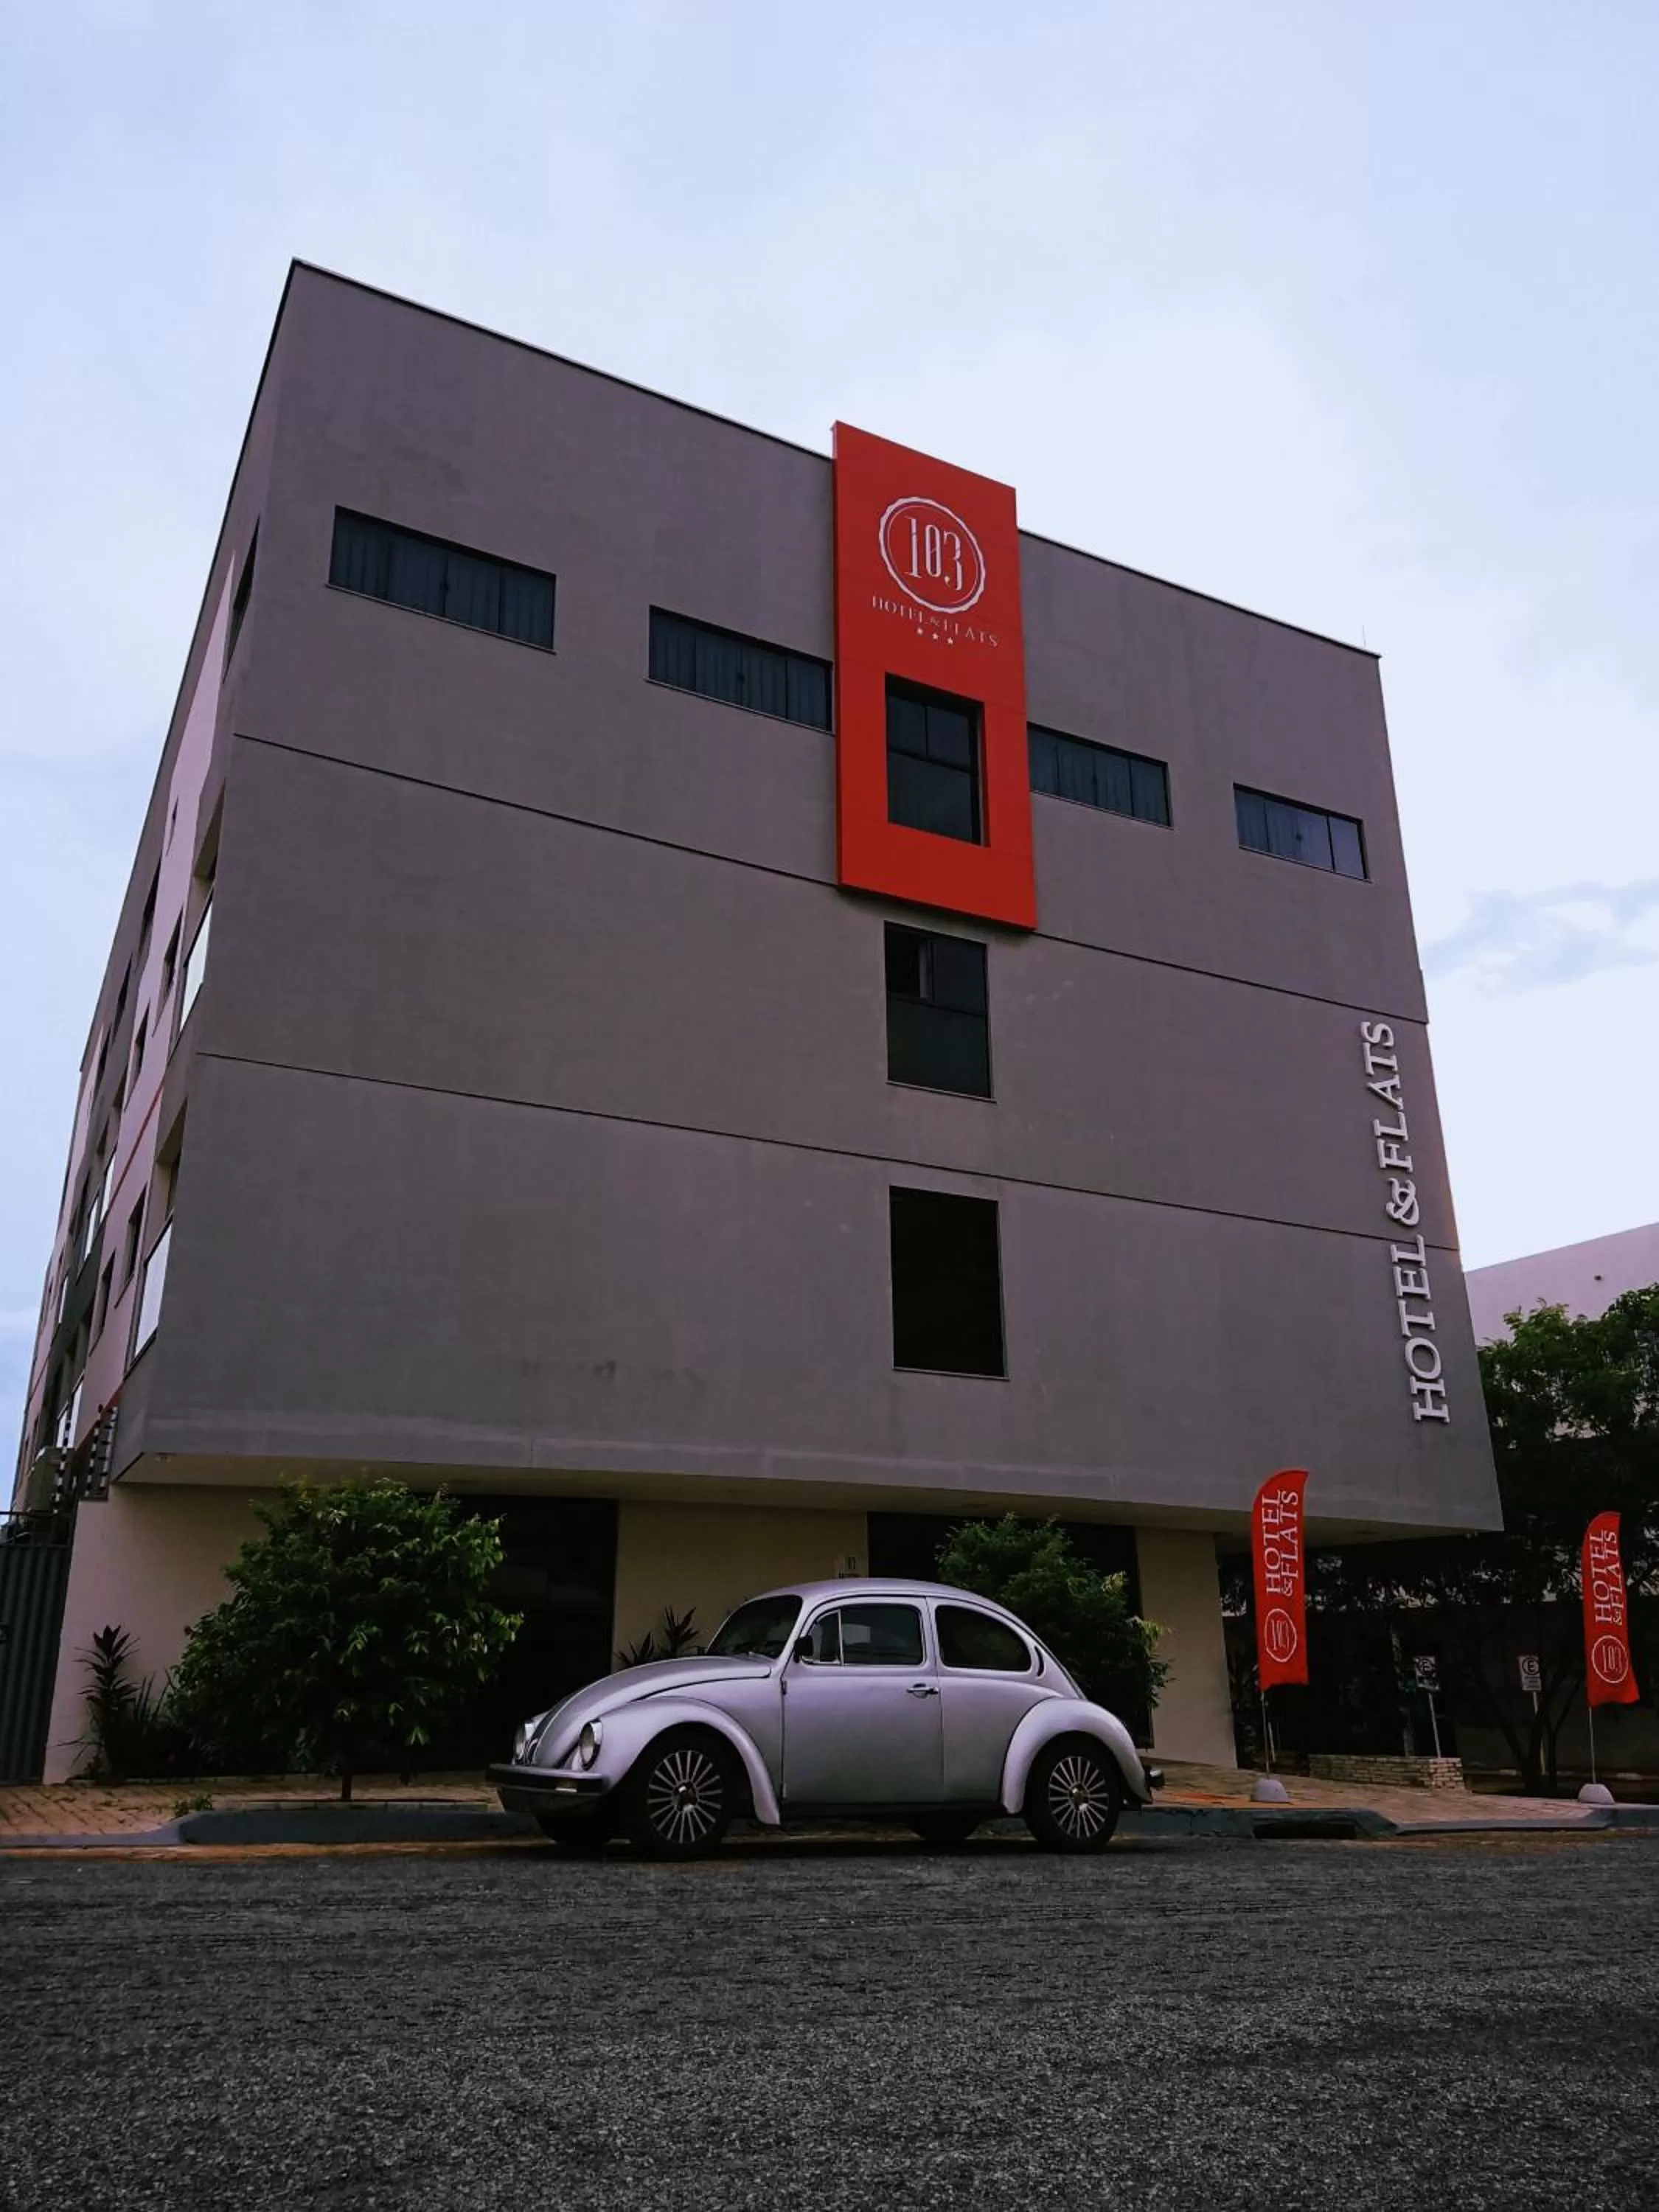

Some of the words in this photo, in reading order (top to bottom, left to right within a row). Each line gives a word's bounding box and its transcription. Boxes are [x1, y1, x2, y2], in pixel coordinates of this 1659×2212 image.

[904, 515, 963, 591] 103
[1361, 1020, 1413, 1173] FLATS
[1385, 1178, 1421, 1227] &
[1391, 1234, 1450, 1425] HOTEL
[1262, 1489, 1281, 1594] HOTEL
[1590, 1530, 1613, 1624] HOTEL
[1527, 1660, 1535, 1672] E
